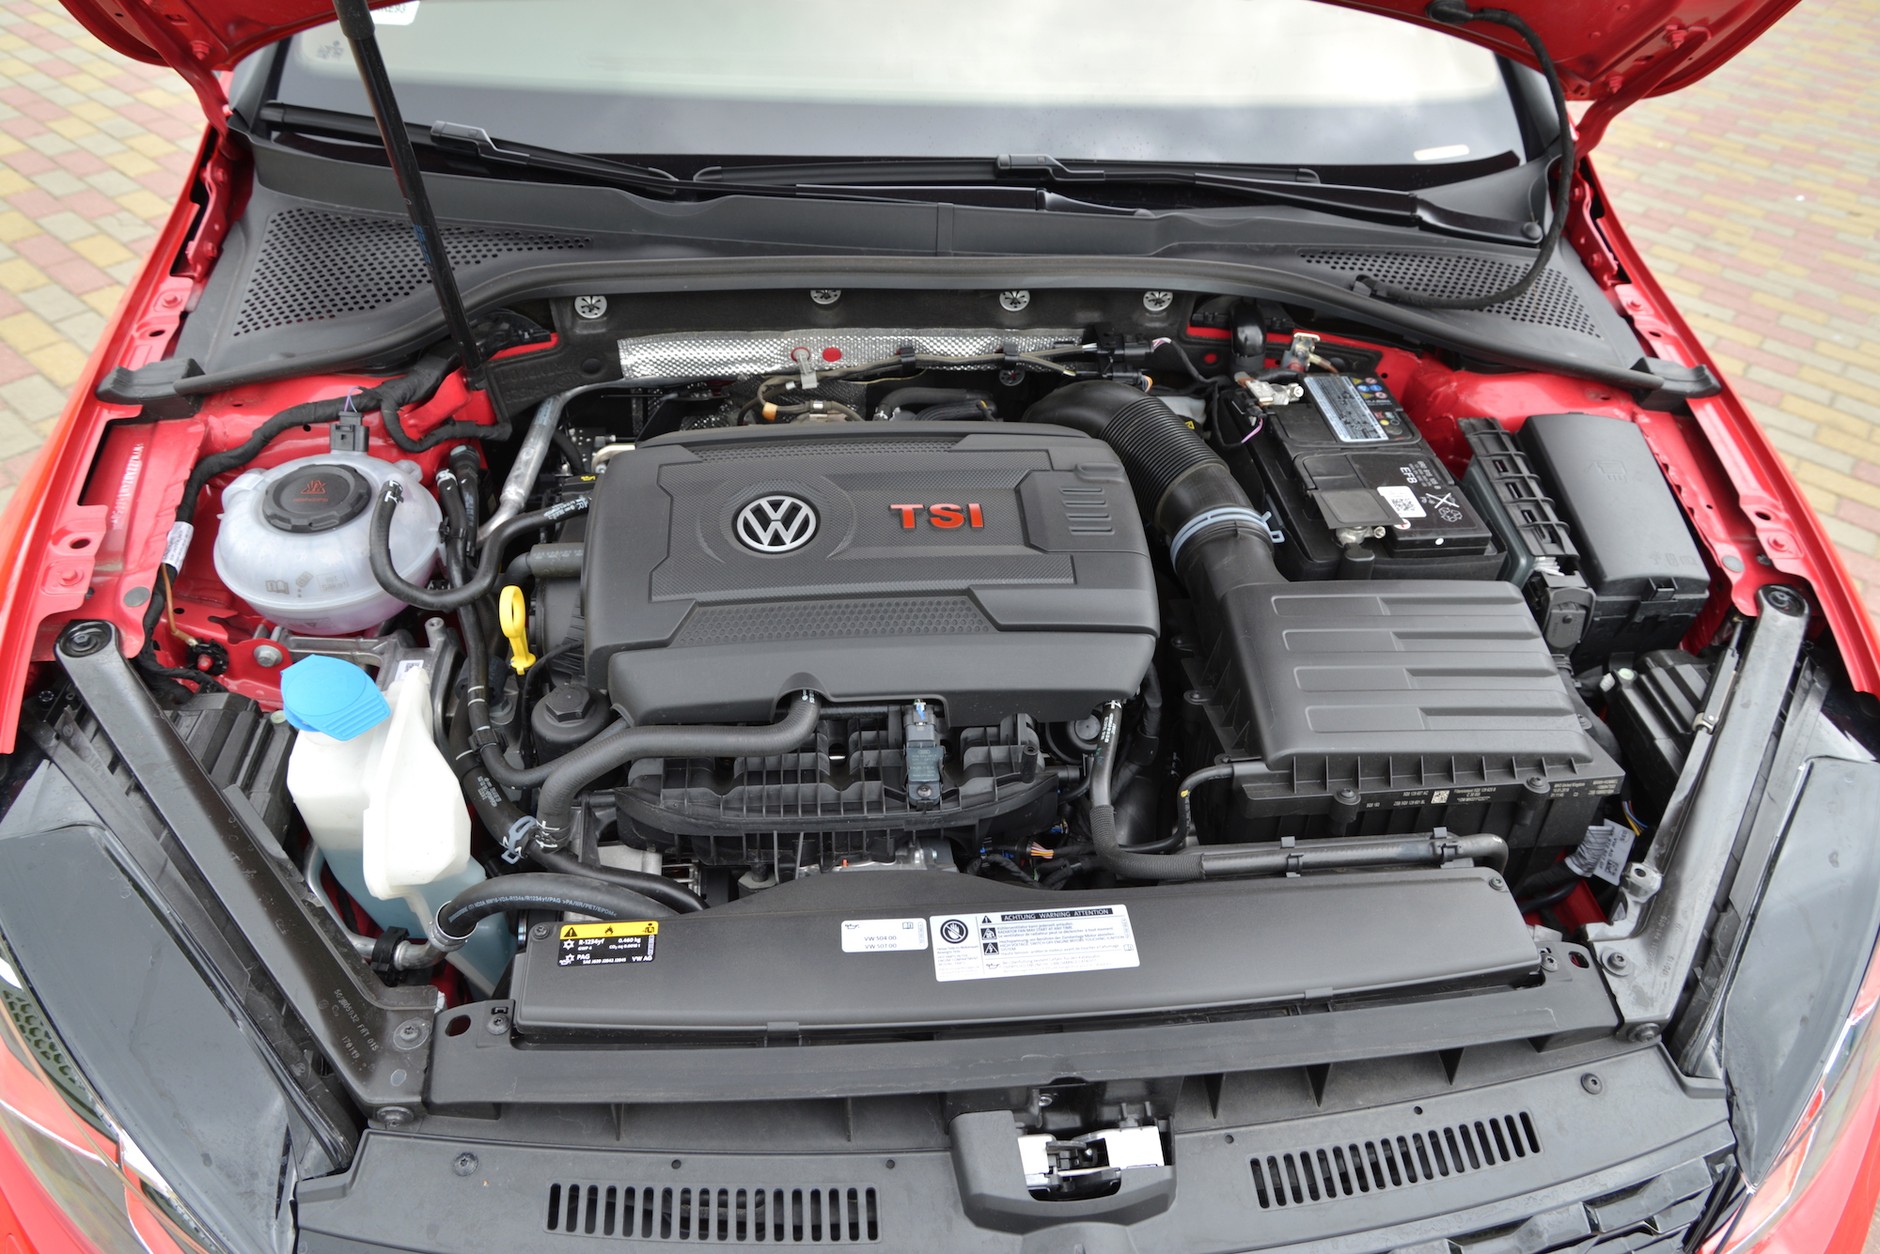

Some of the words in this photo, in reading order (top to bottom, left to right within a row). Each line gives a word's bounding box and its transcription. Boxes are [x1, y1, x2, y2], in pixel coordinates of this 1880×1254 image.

[1400, 467, 1418, 484] EFB
[741, 498, 812, 548] VW
[890, 503, 984, 529] TSI
[1612, 838, 1617, 847] VW
[578, 938, 605, 946] R-1234yf
